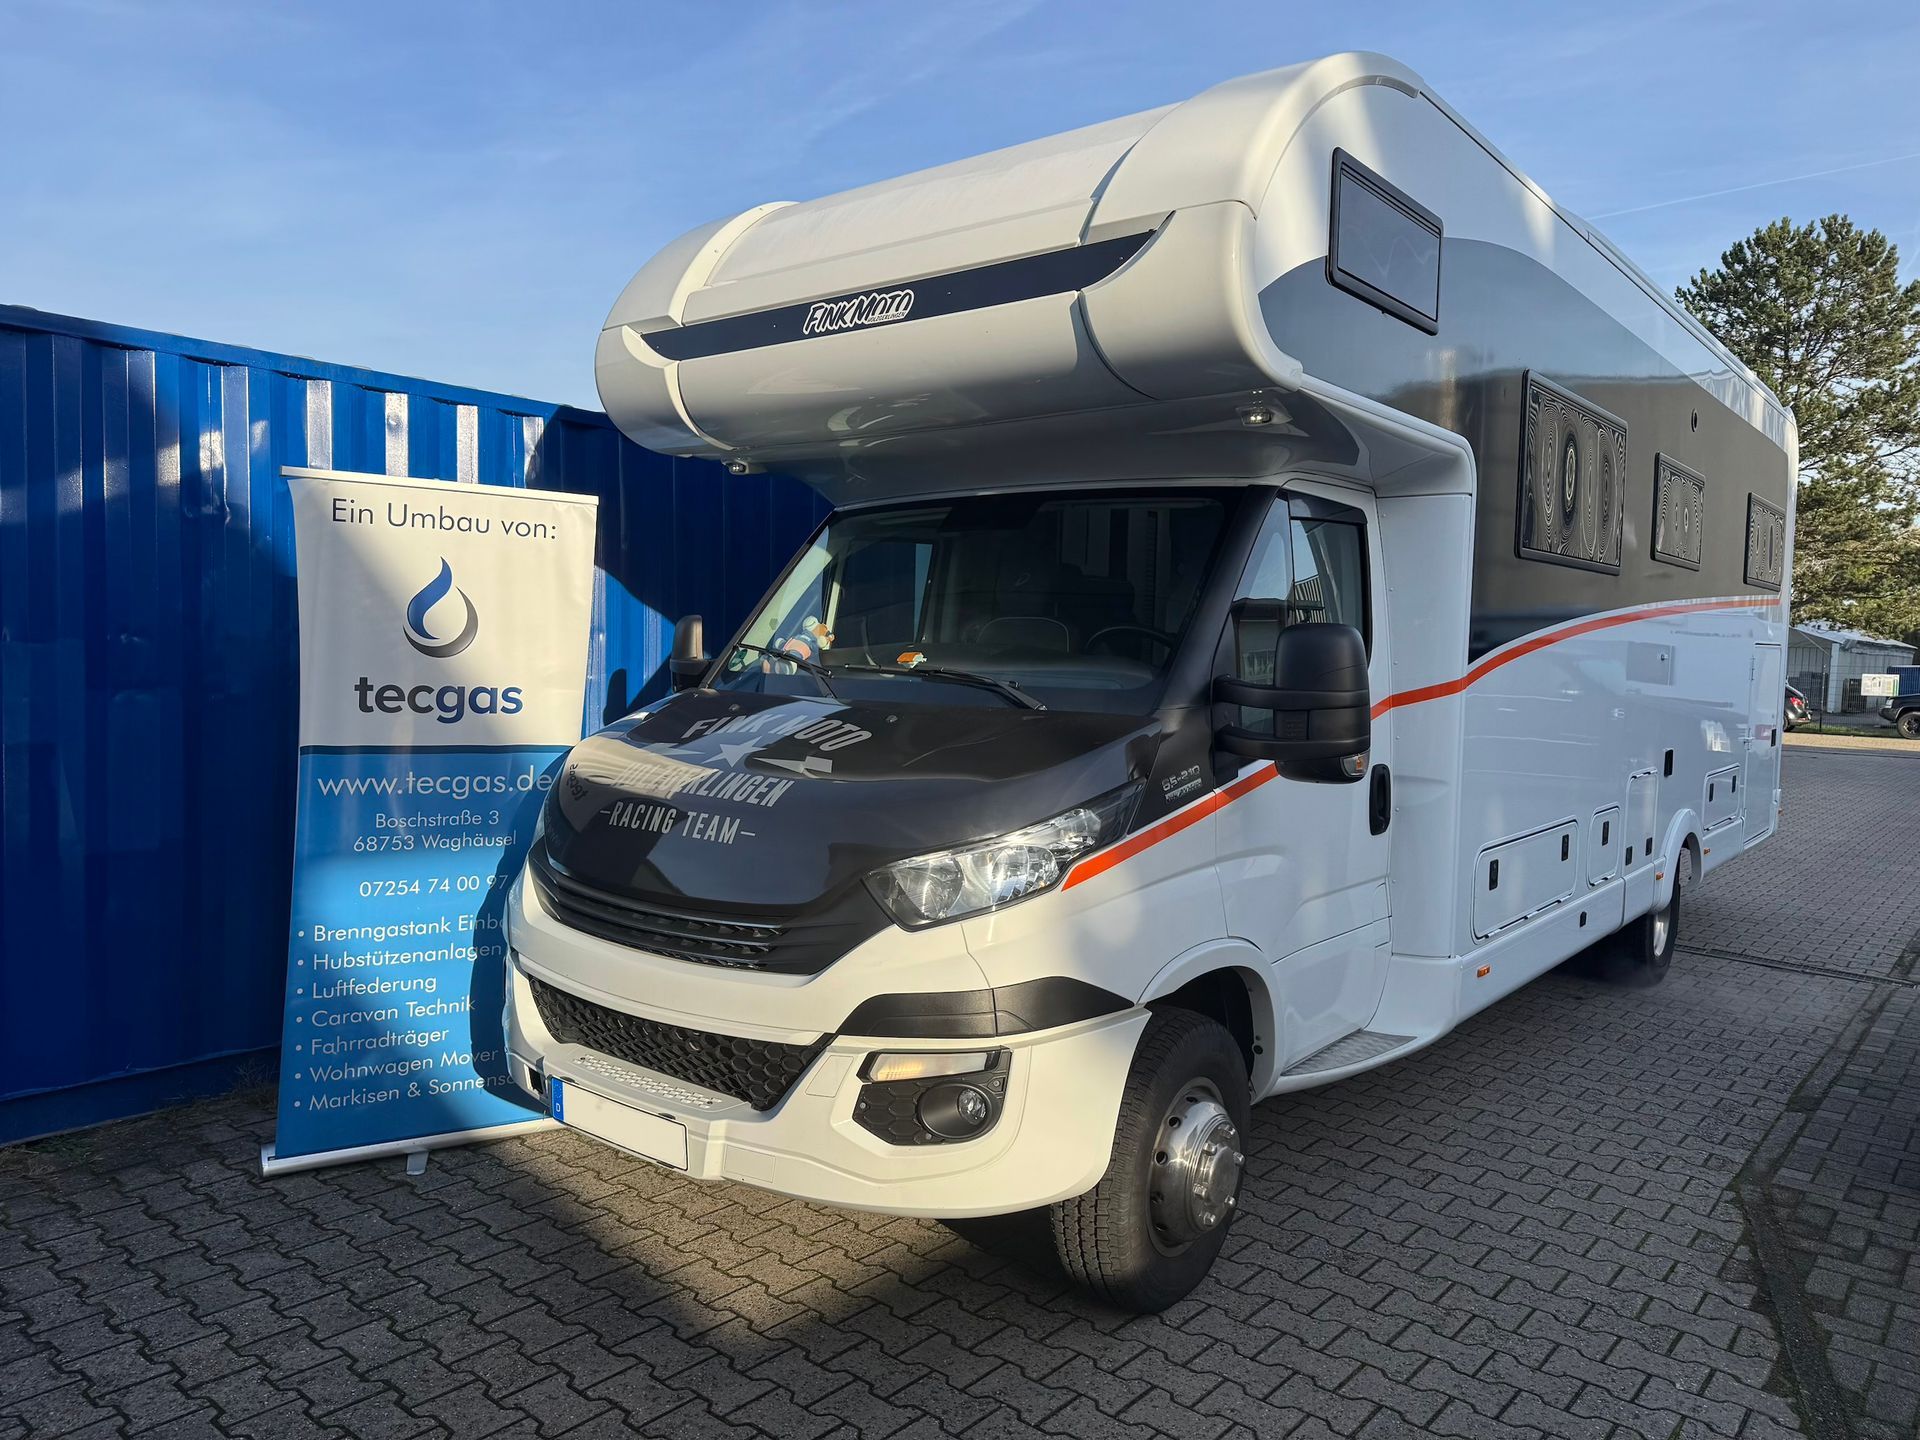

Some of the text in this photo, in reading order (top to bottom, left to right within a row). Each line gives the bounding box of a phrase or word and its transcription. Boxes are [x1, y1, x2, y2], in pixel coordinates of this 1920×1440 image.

[804, 290, 913, 332] FINK MOTO
[332, 497, 557, 540] Ein Umbau von:
[354, 676, 523, 724] tecgas
[682, 713, 872, 751] FINK MOTO
[317, 765, 552, 800] www.tecgas.de
[375, 810, 499, 829] Boschstraße 3
[353, 830, 516, 852] 68753 Waghäusel
[359, 875, 509, 897] 07254 74 00 97
[314, 916, 451, 943] Brenngastank
[313, 943, 502, 970] Hubstützenanlagen
[312, 976, 437, 999] Luftfederung
[311, 995, 476, 1027] Caravan Technik
[311, 1029, 449, 1056] Fahrradträger
[309, 1049, 498, 1083] Wohnwagen Mover
[308, 1087, 399, 1111] Markisen
[407, 1082, 421, 1098] &
